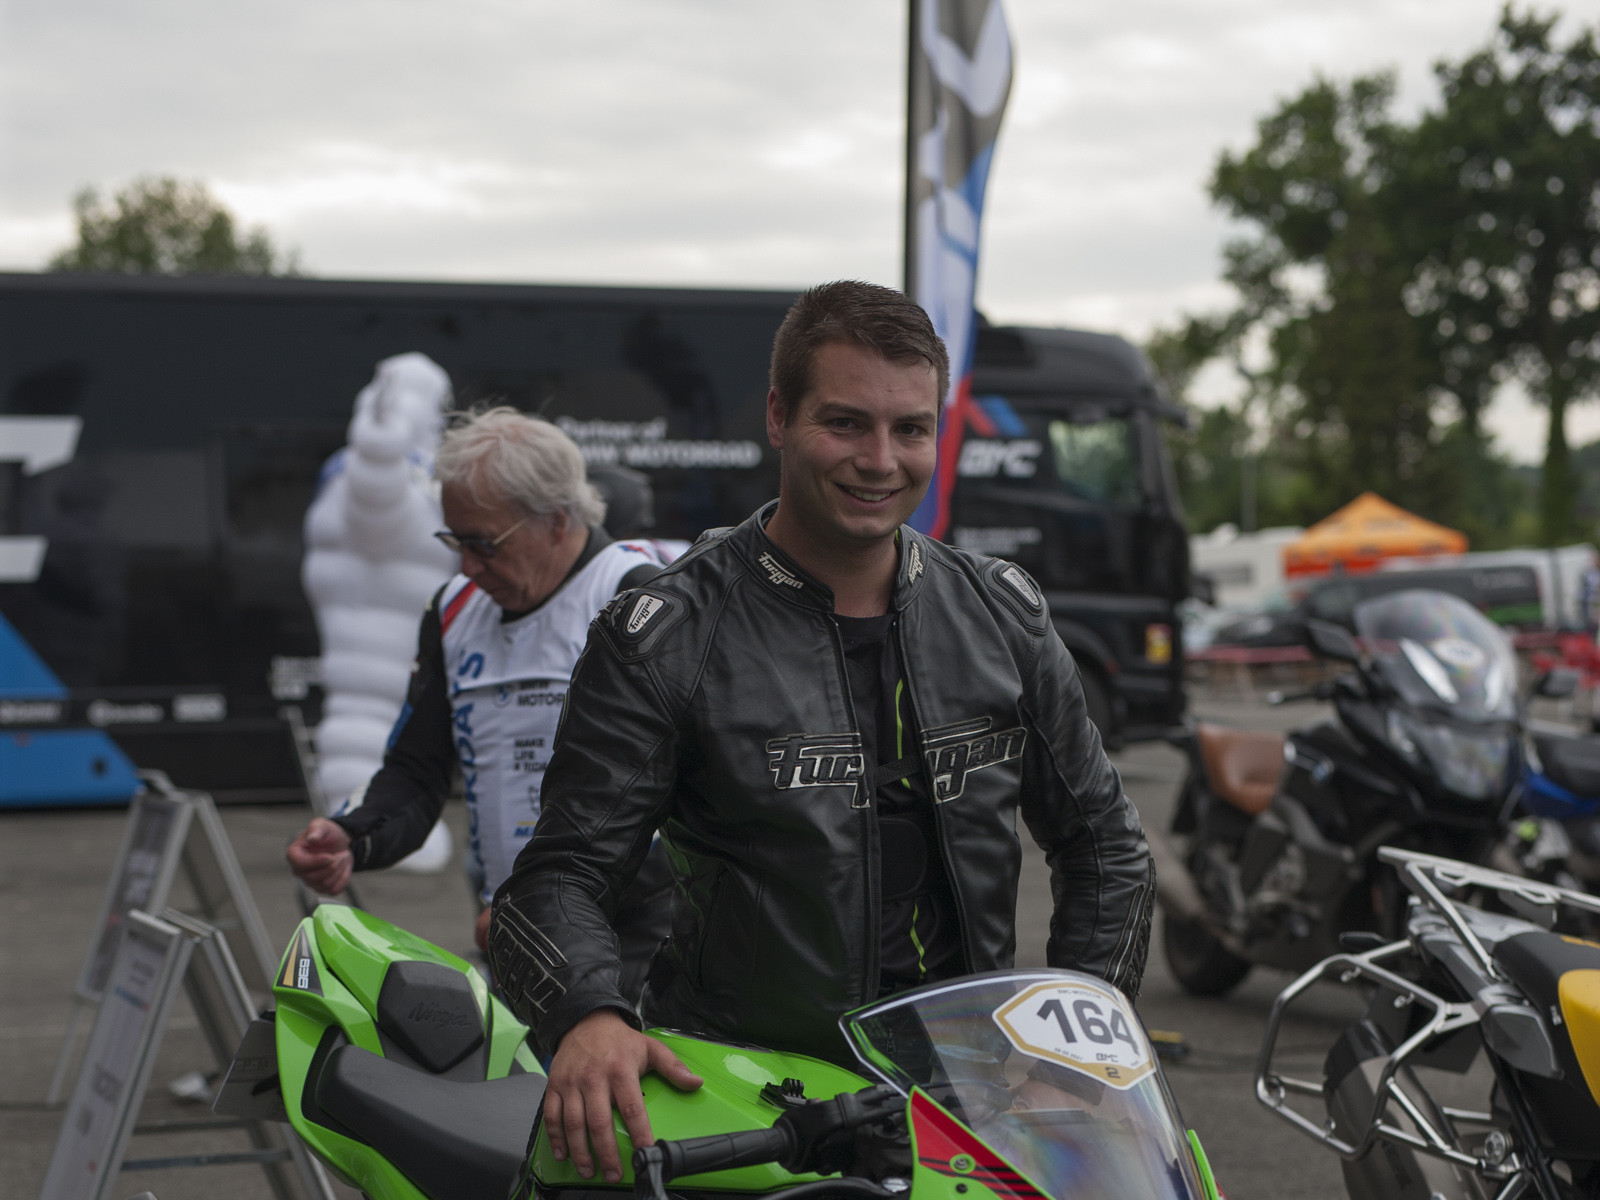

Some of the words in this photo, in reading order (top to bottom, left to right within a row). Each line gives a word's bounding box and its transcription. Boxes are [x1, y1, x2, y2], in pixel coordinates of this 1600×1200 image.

[624, 440, 763, 468] MOTORRAD
[1036, 998, 1141, 1057] 164
[1105, 1066, 1121, 1079] 2
